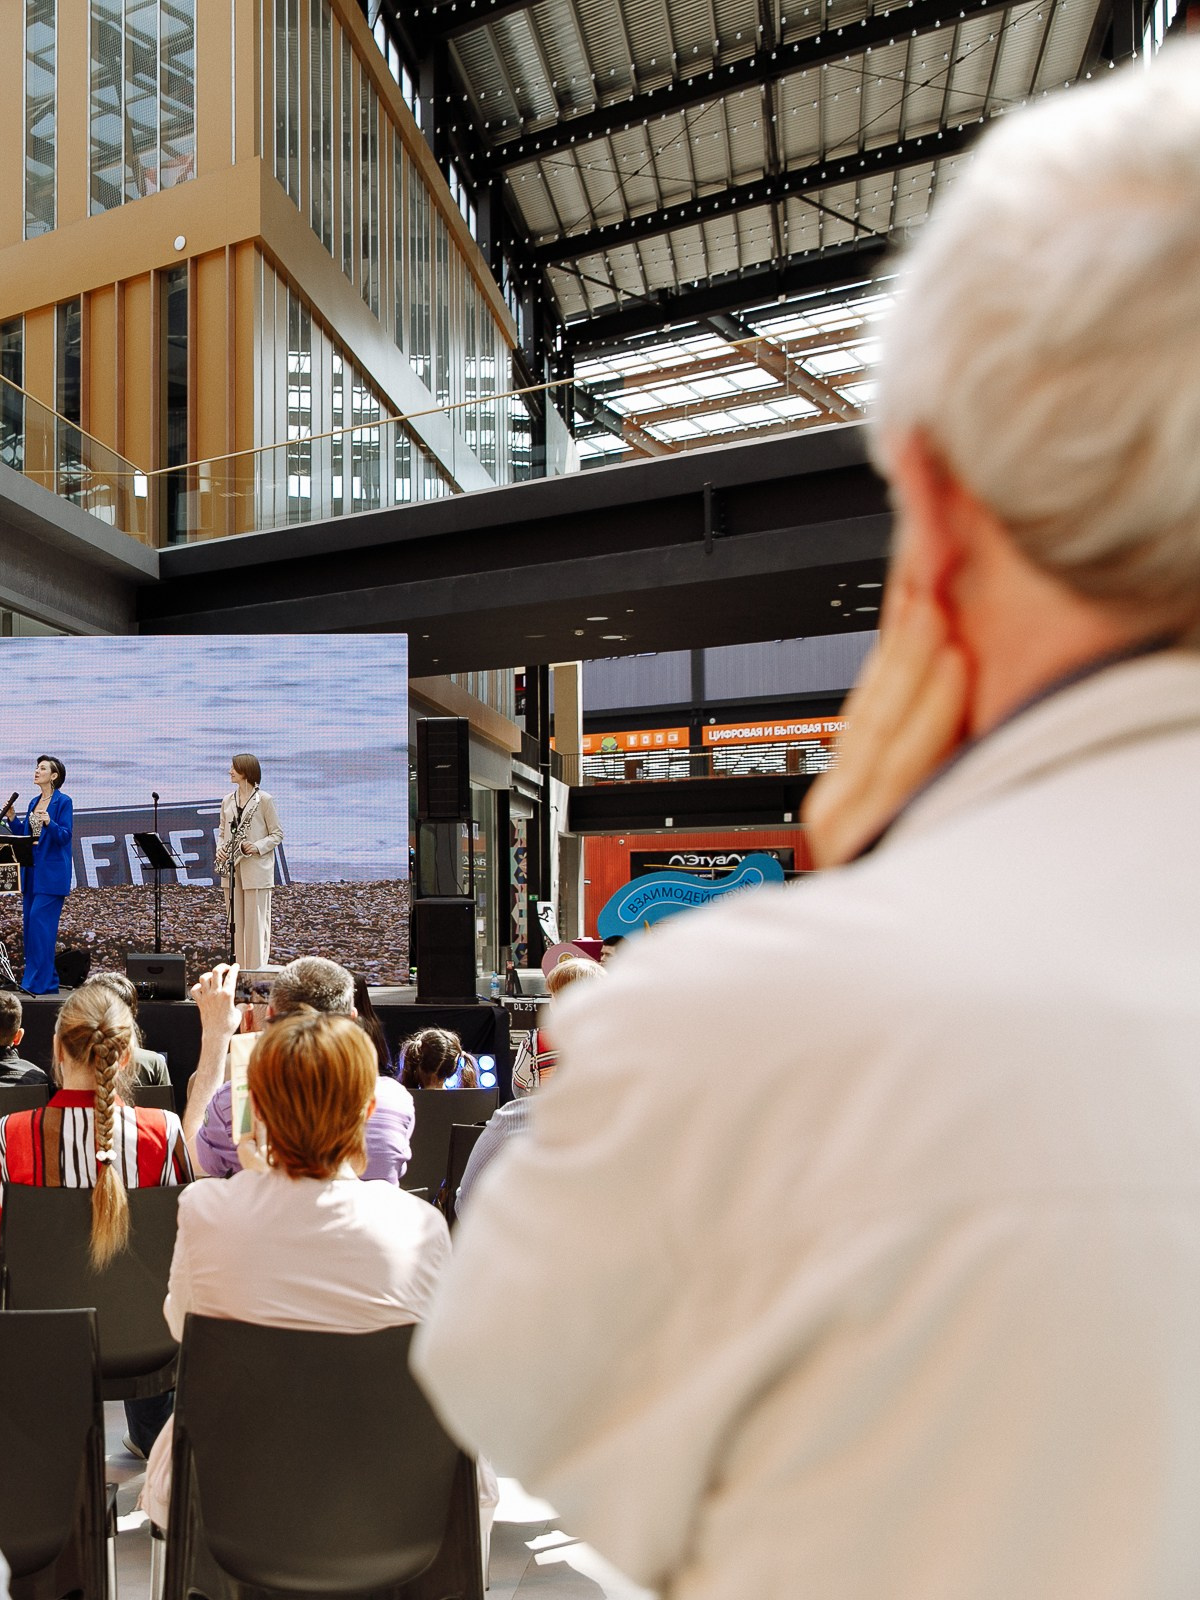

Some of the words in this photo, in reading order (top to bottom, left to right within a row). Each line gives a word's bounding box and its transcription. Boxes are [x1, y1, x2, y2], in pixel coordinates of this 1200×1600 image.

[708, 727, 763, 741] ЦИФРОВАЯ
[764, 726, 773, 737] И
[774, 723, 821, 737] БЫТОВАЯ
[513, 1002, 524, 1011] DL
